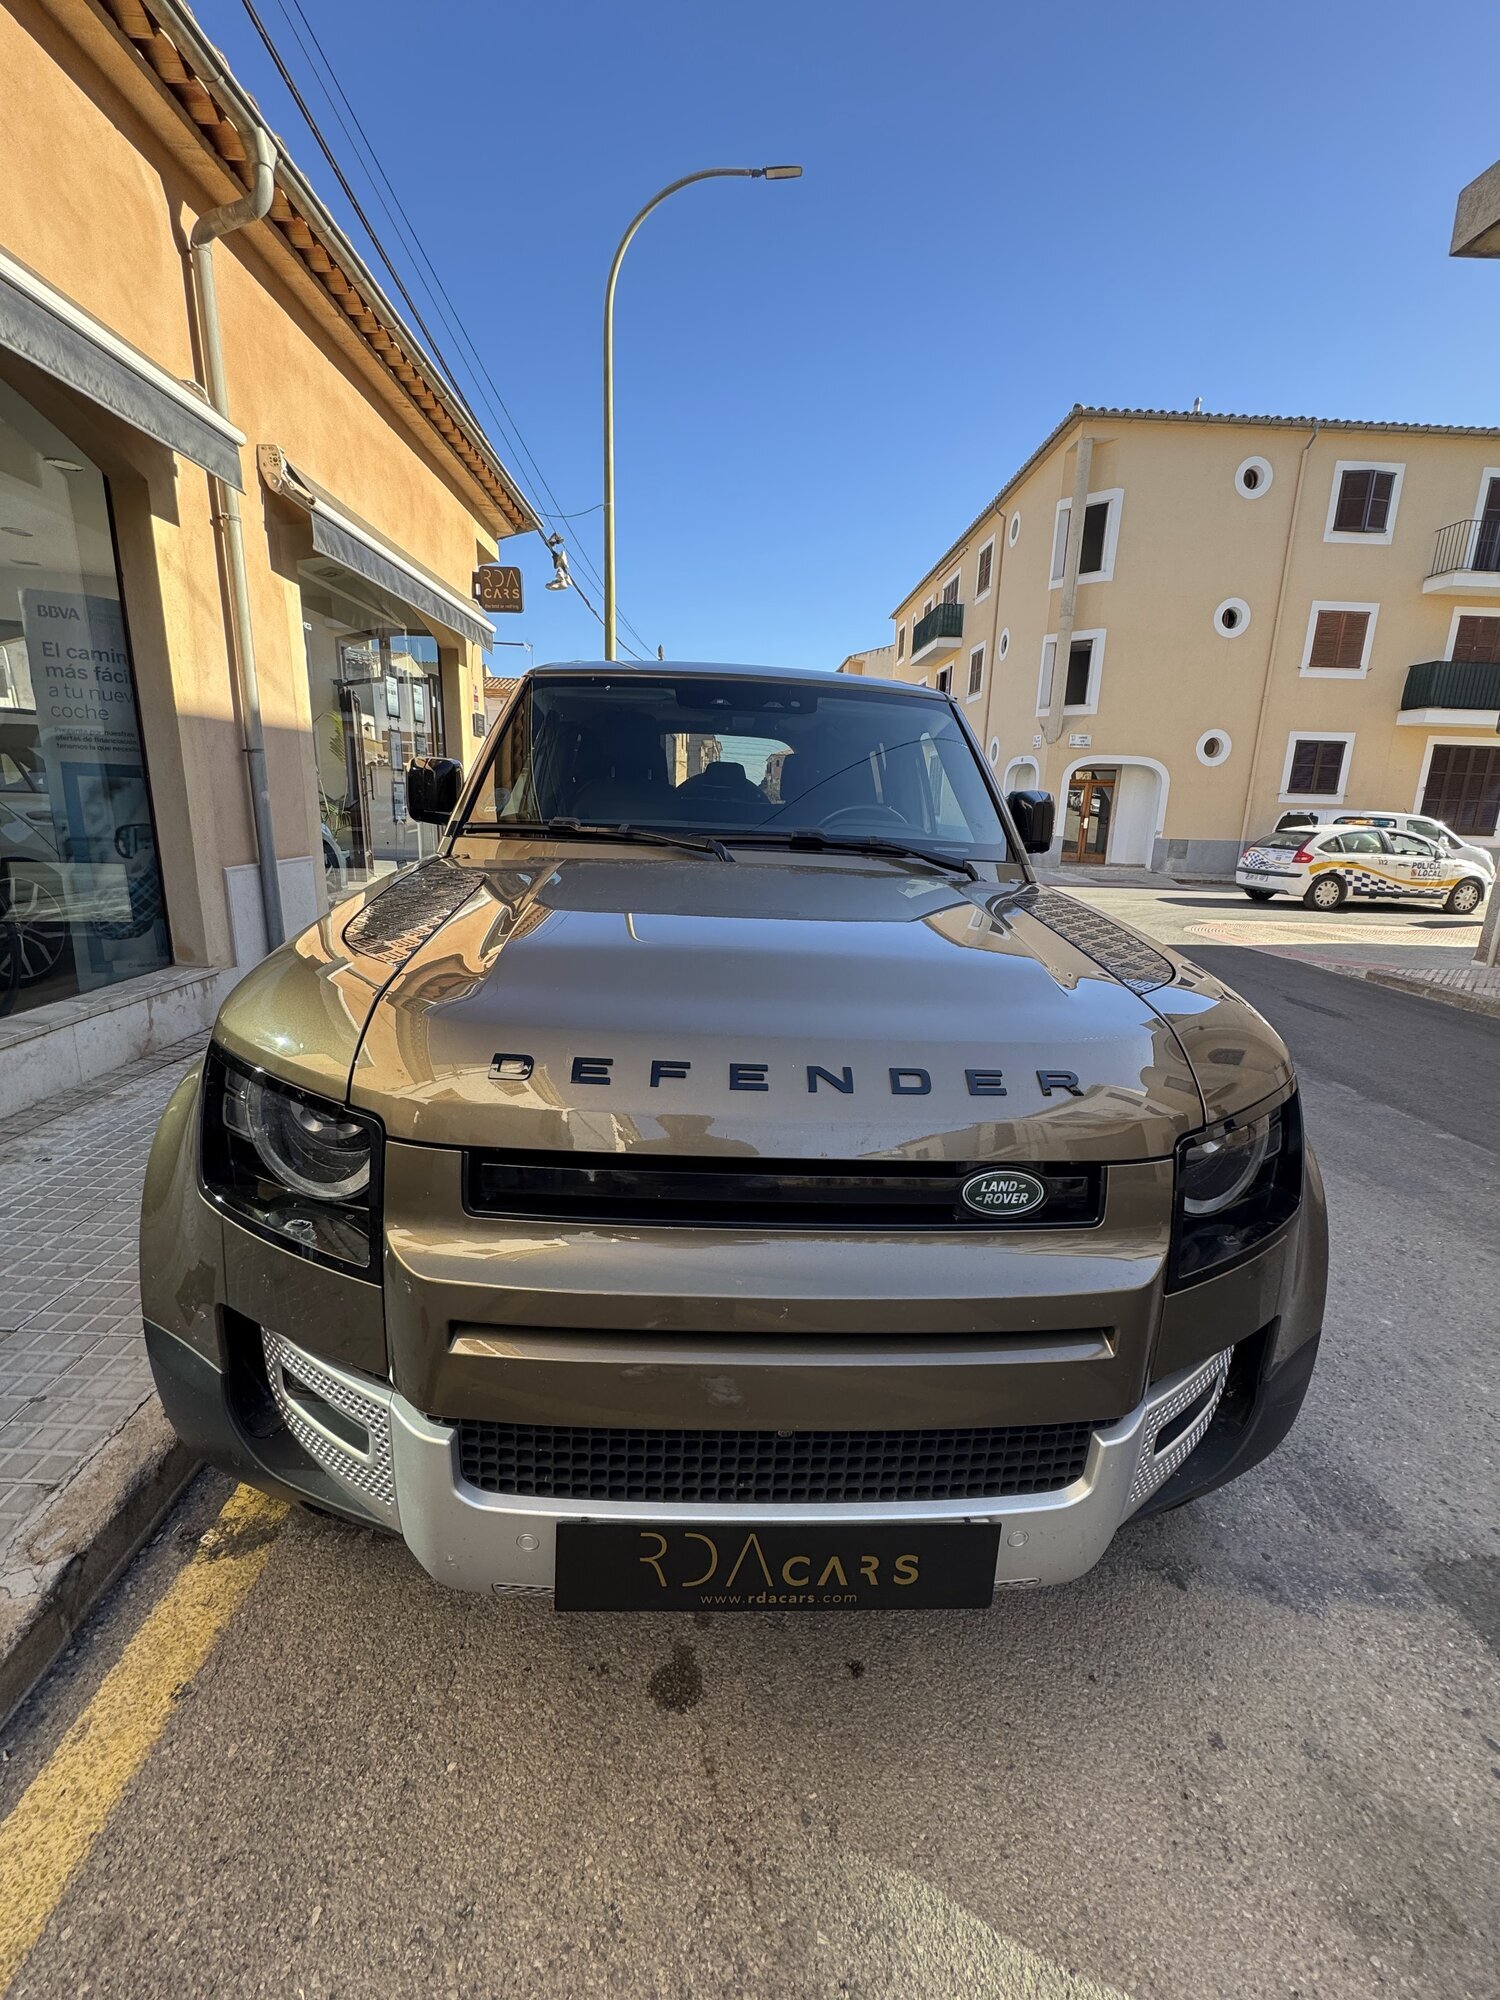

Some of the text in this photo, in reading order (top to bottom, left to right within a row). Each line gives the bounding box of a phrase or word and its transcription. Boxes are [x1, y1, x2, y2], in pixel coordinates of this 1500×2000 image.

[483, 569, 519, 587] RDA
[483, 588, 520, 599] CARS
[37, 604, 80, 620] BBVA
[42, 641, 128, 664] El camin
[45, 663, 129, 684] más fáci
[48, 682, 133, 703] a tu nuev
[50, 704, 109, 720] coche
[1417, 869, 1441, 877] LOCAL
[487, 1052, 1085, 1097] DEFENDER
[980, 1181, 1018, 1192] LAND
[983, 1193, 1029, 1204] ROVER
[700, 1591, 857, 1604] www.rdacars.com
